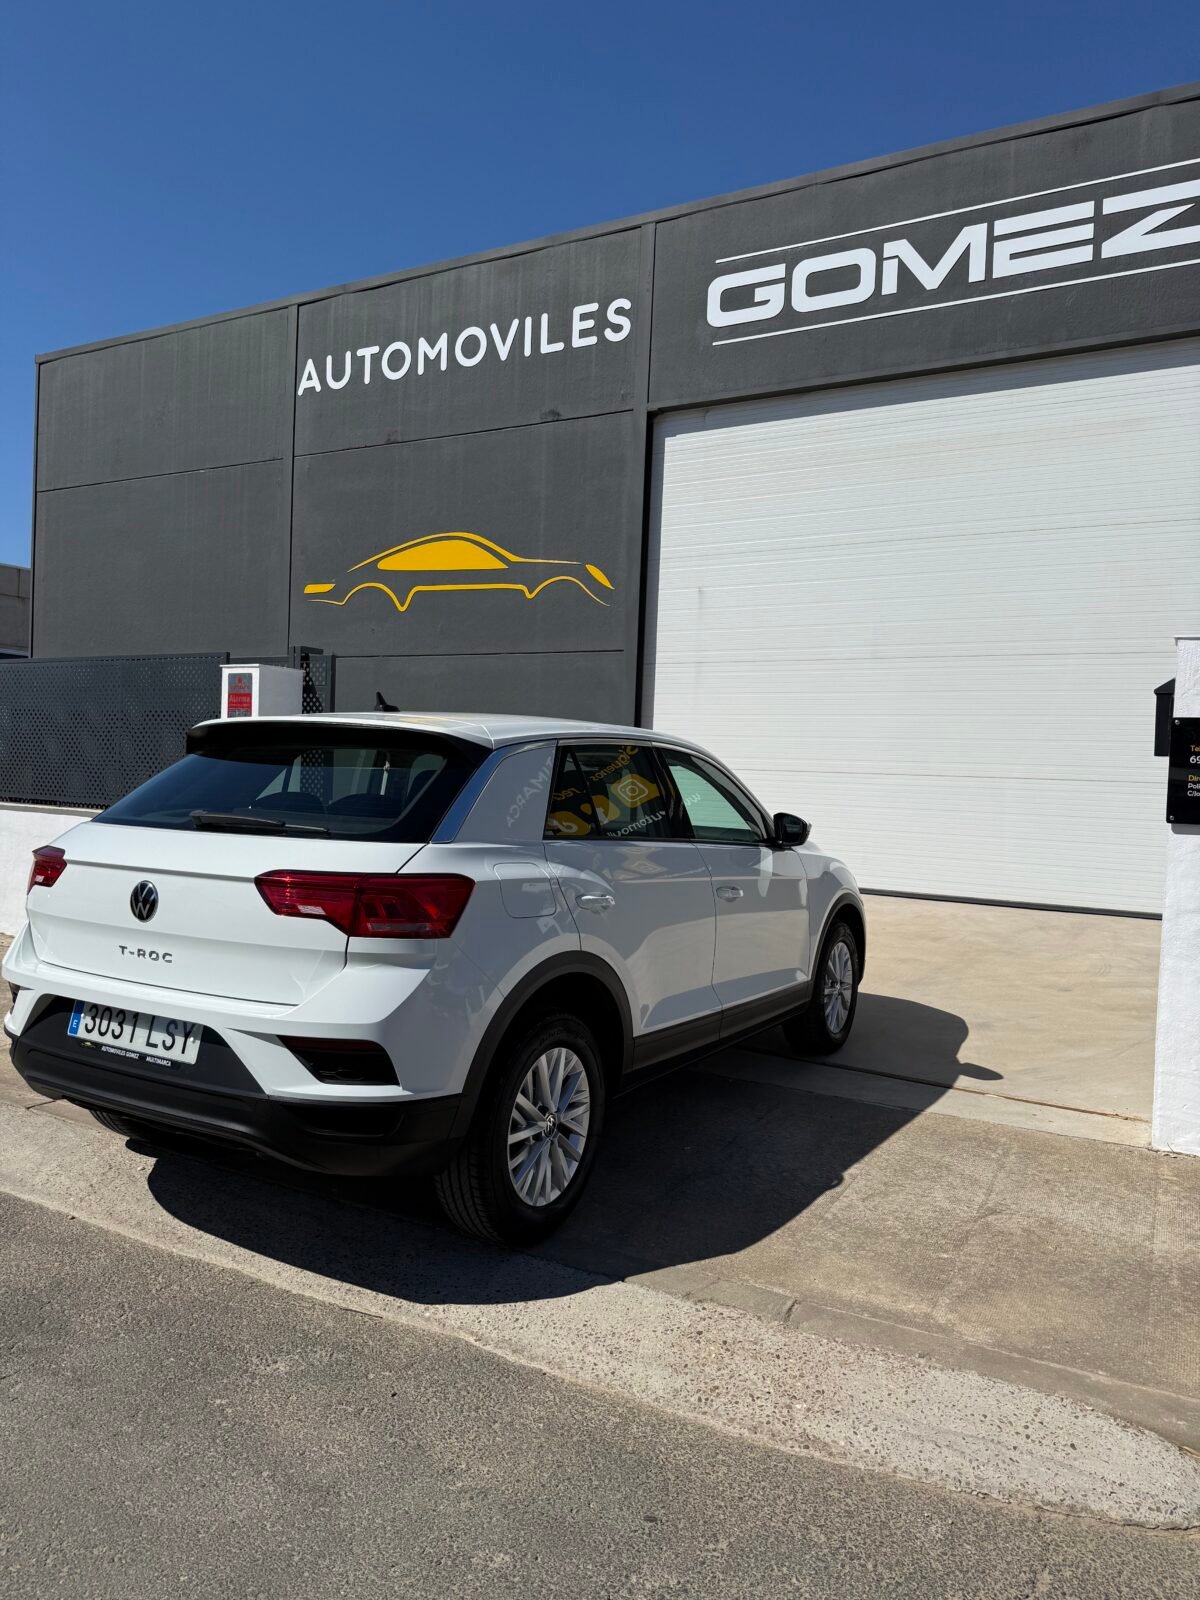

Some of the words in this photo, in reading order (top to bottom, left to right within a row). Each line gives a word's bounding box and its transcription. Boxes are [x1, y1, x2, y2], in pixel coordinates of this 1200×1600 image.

[706, 179, 1200, 328] GOMEZ
[297, 298, 632, 396] AUTOMOVILES
[118, 945, 173, 964] T-ROC
[72, 1019, 78, 1028] E
[84, 1004, 139, 1043] 3031
[145, 1015, 197, 1055] LSY
